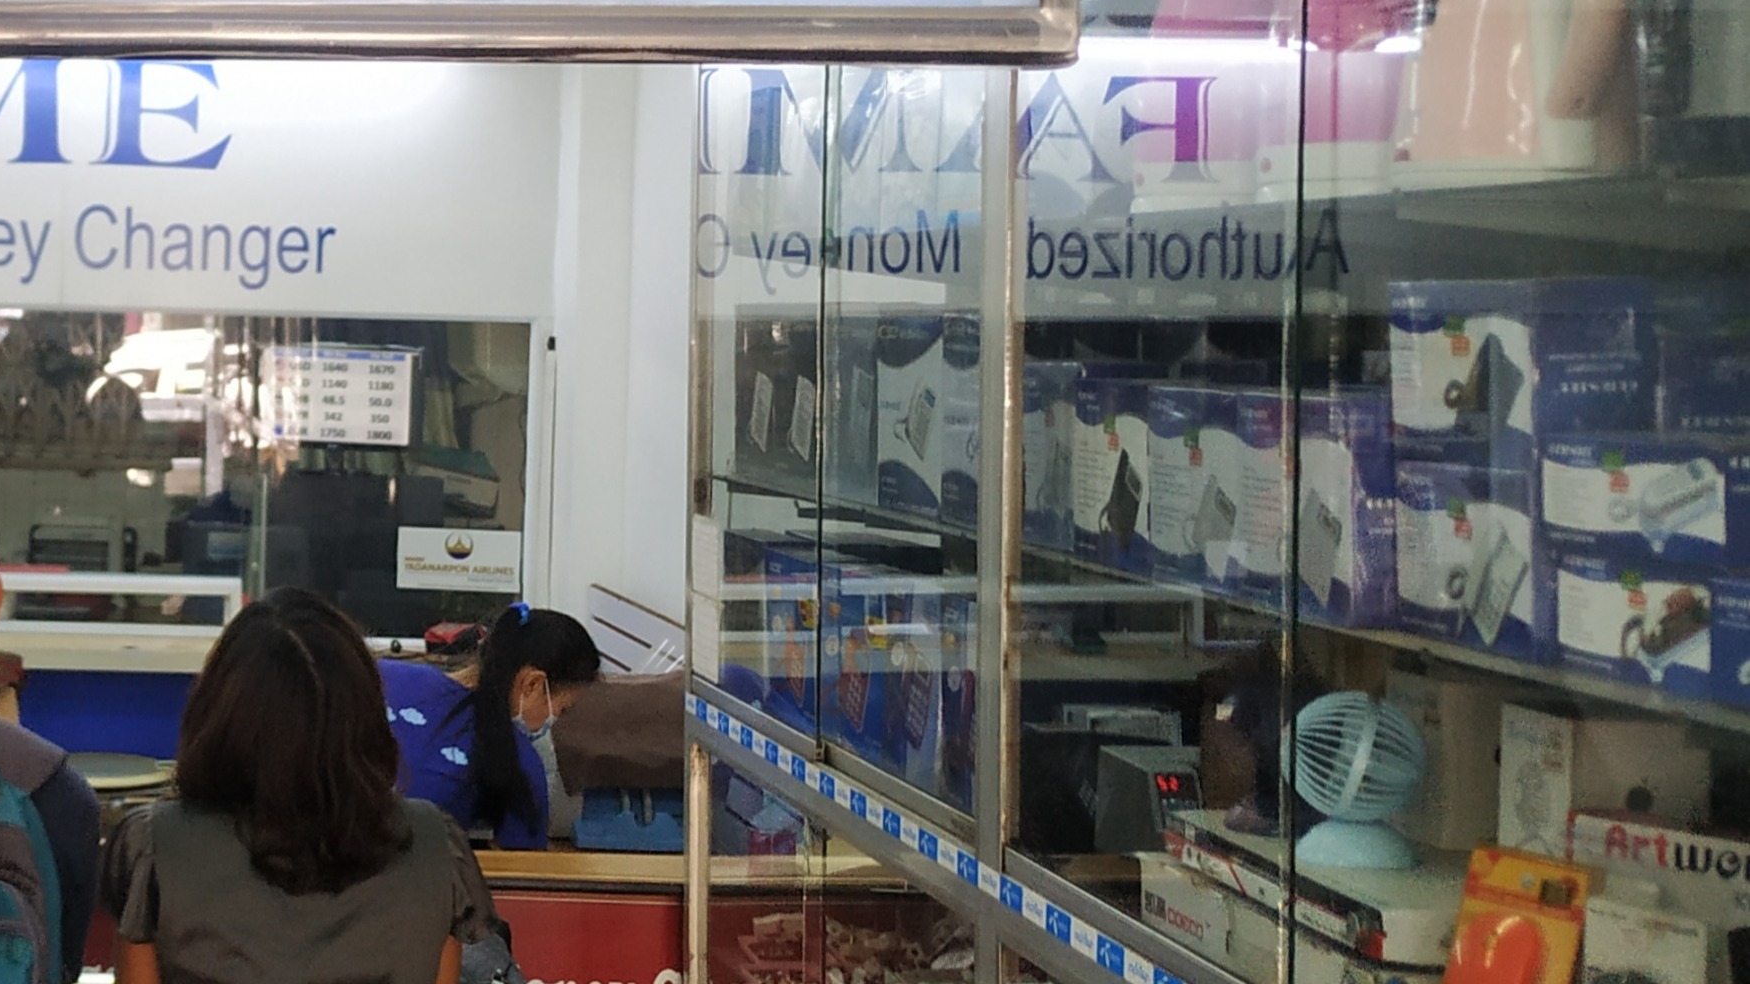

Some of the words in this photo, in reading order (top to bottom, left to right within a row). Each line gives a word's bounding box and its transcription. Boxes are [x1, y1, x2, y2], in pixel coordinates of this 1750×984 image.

[74, 203, 338, 291] Changer
[321, 362, 348, 373] 1640
[368, 364, 395, 375] 1670
[321, 379, 347, 389] 1140
[322, 395, 346, 405] 48.5
[368, 398, 393, 407] 50.0
[319, 427, 346, 438] 1750
[366, 430, 393, 441] 1800
[473, 565, 515, 576] AIRLINES
